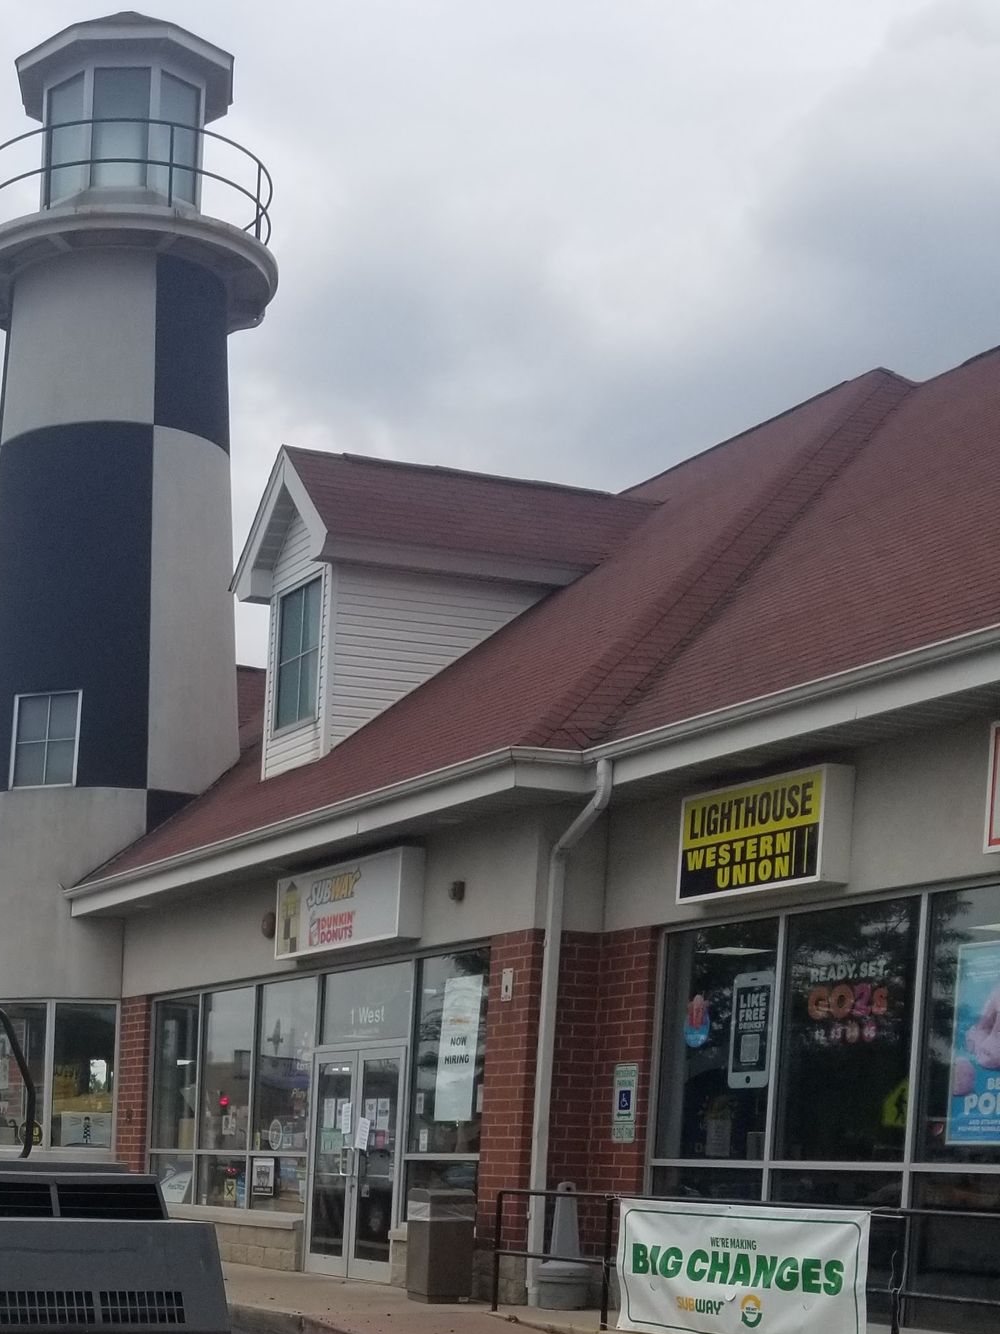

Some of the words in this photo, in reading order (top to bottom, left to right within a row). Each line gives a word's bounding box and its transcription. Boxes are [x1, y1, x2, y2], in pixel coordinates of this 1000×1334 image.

[689, 781, 814, 840] LIGHTHOUSE
[687, 831, 791, 871] WESTERN
[717, 855, 789, 888] UNION
[306, 867, 361, 911] SUBWAY
[320, 925, 353, 944] DONUTS
[740, 992, 767, 1008] LIKE
[350, 1008, 355, 1025] 1
[359, 1006, 385, 1024] West
[739, 1007, 766, 1021] FREE
[450, 1037, 467, 1046] NOW
[444, 1054, 470, 1065] HIRING
[710, 1236, 730, 1249] WE'RE
[730, 1238, 757, 1250] MAKING
[632, 1243, 683, 1279] BIG
[686, 1249, 844, 1296] CHANGES
[676, 1295, 725, 1316] SUBWAY
